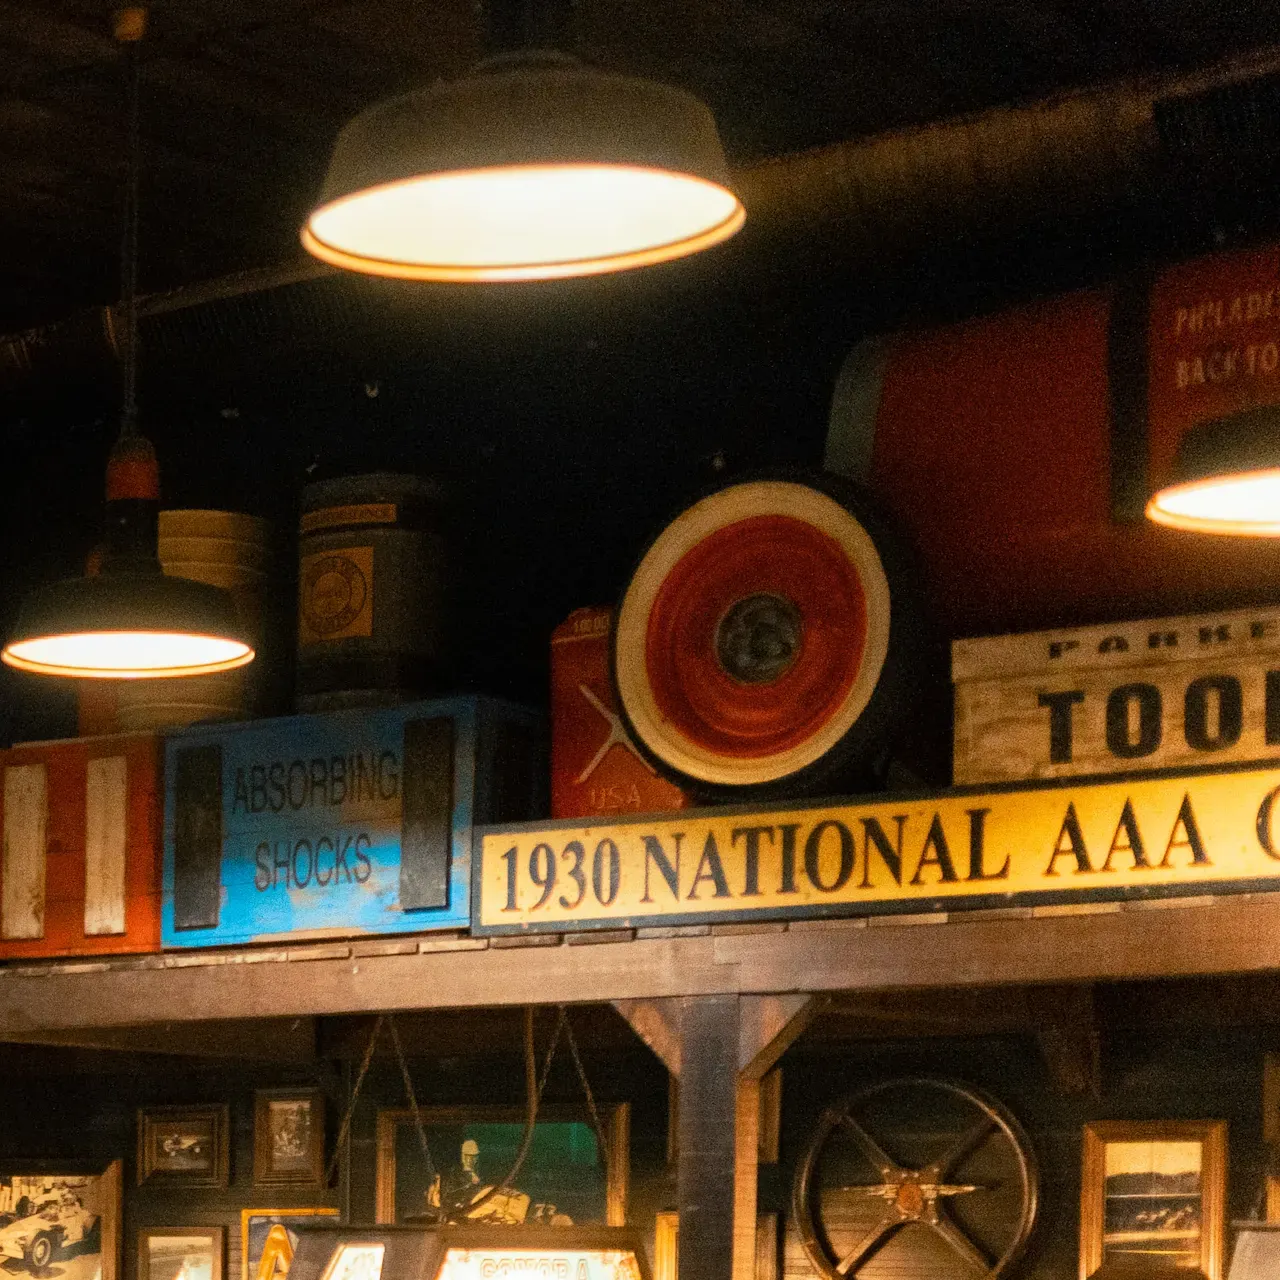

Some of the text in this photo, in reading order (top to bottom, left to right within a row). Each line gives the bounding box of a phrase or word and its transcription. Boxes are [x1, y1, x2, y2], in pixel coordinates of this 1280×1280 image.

[231, 750, 399, 814] ABSORBING
[253, 834, 373, 892] SHOCKS
[500, 835, 621, 914] 1930
[639, 805, 1014, 903] NATIONAL
[1043, 789, 1213, 878] AAA
